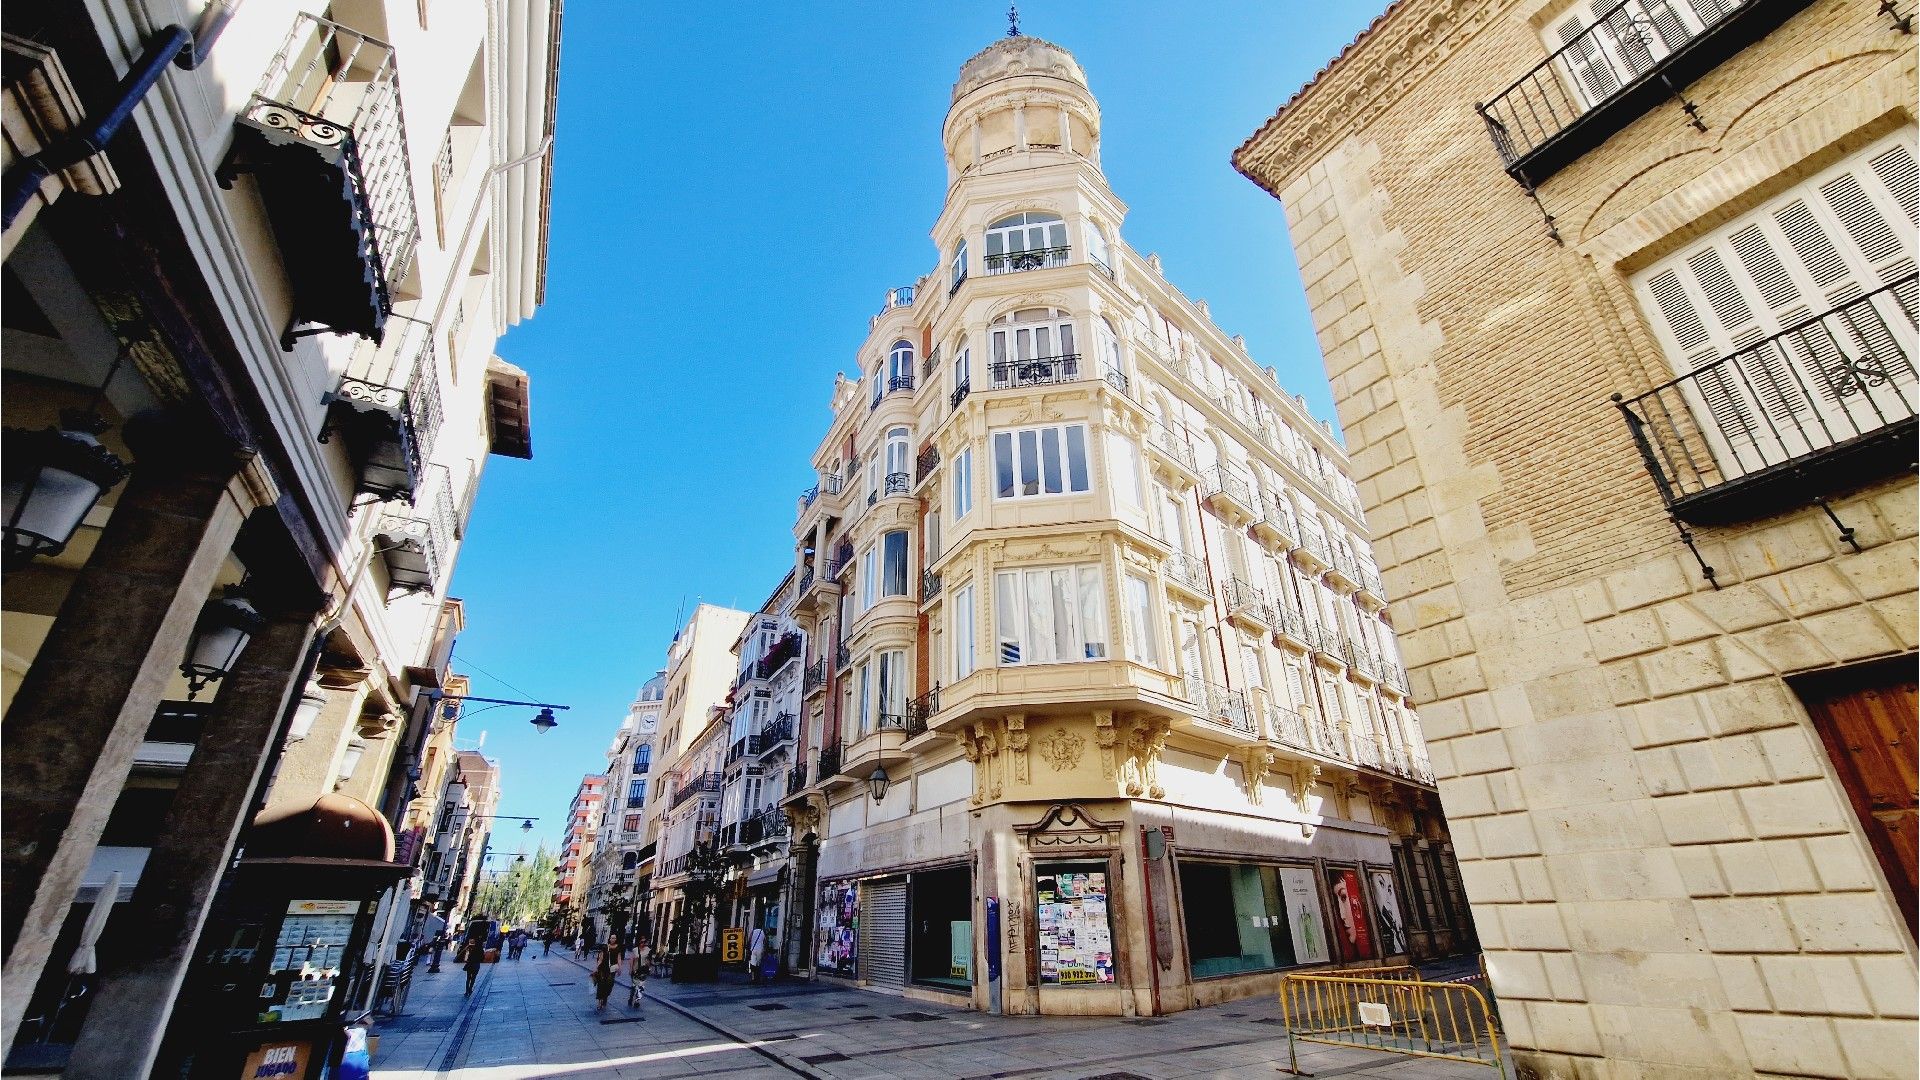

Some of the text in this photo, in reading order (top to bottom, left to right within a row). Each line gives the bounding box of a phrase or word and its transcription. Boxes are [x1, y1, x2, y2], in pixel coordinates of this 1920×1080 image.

[727, 933, 738, 960] ORO
[263, 1045, 297, 1065] BIEN
[255, 1061, 298, 1078] JUGADO
